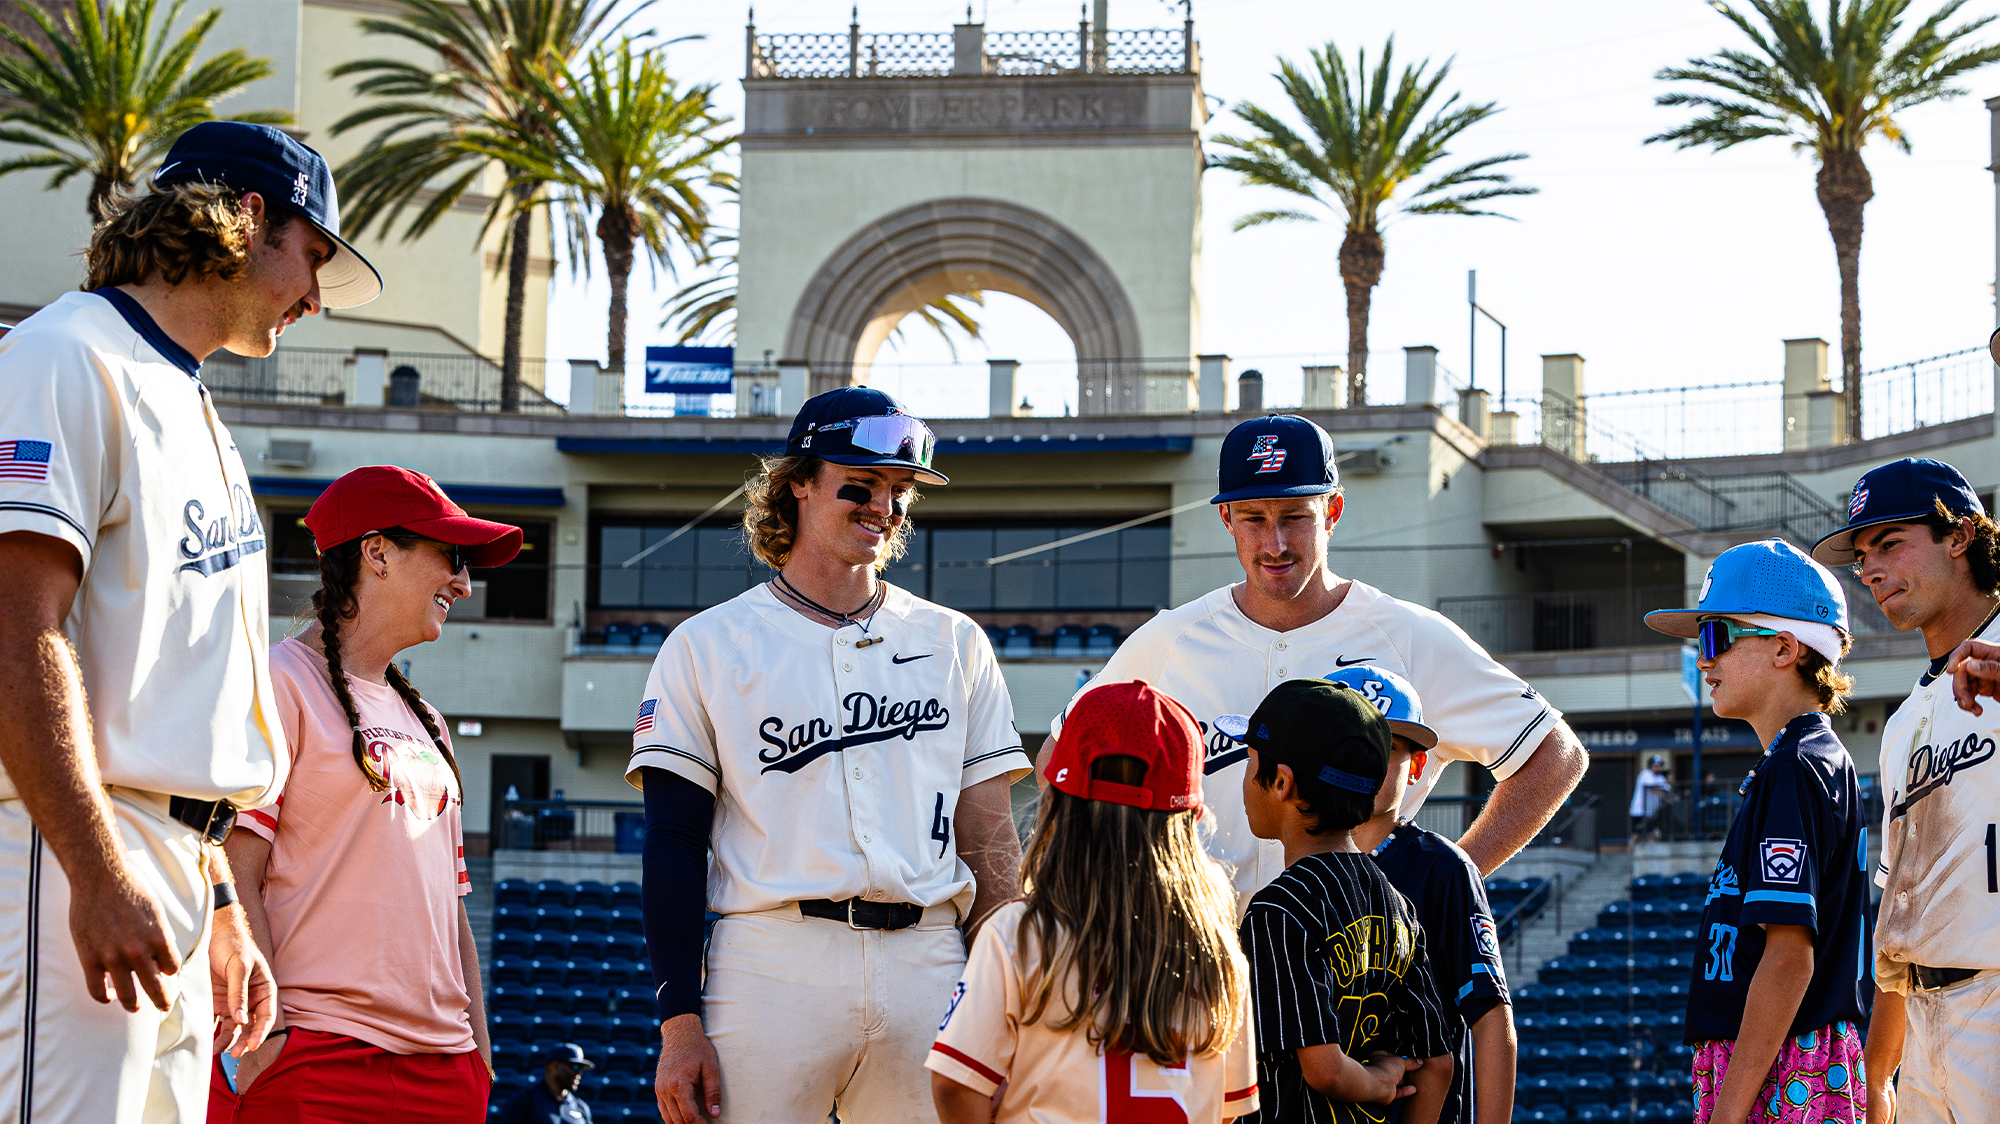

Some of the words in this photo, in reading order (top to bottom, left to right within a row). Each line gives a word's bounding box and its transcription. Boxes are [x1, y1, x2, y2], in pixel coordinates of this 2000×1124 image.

[826, 95, 987, 125] FOWLER
[1001, 92, 1104, 122] PARK
[291, 187, 308, 207] 33
[294, 172, 309, 190] JC
[802, 435, 813, 449] 33
[758, 716, 833, 763] San
[843, 691, 949, 741] Diego
[1578, 729, 1639, 747] ORERO
[1674, 726, 1731, 744] TRATS
[1906, 732, 1996, 793] Diego
[931, 791, 950, 860] 4
[1704, 922, 1739, 982] 30
